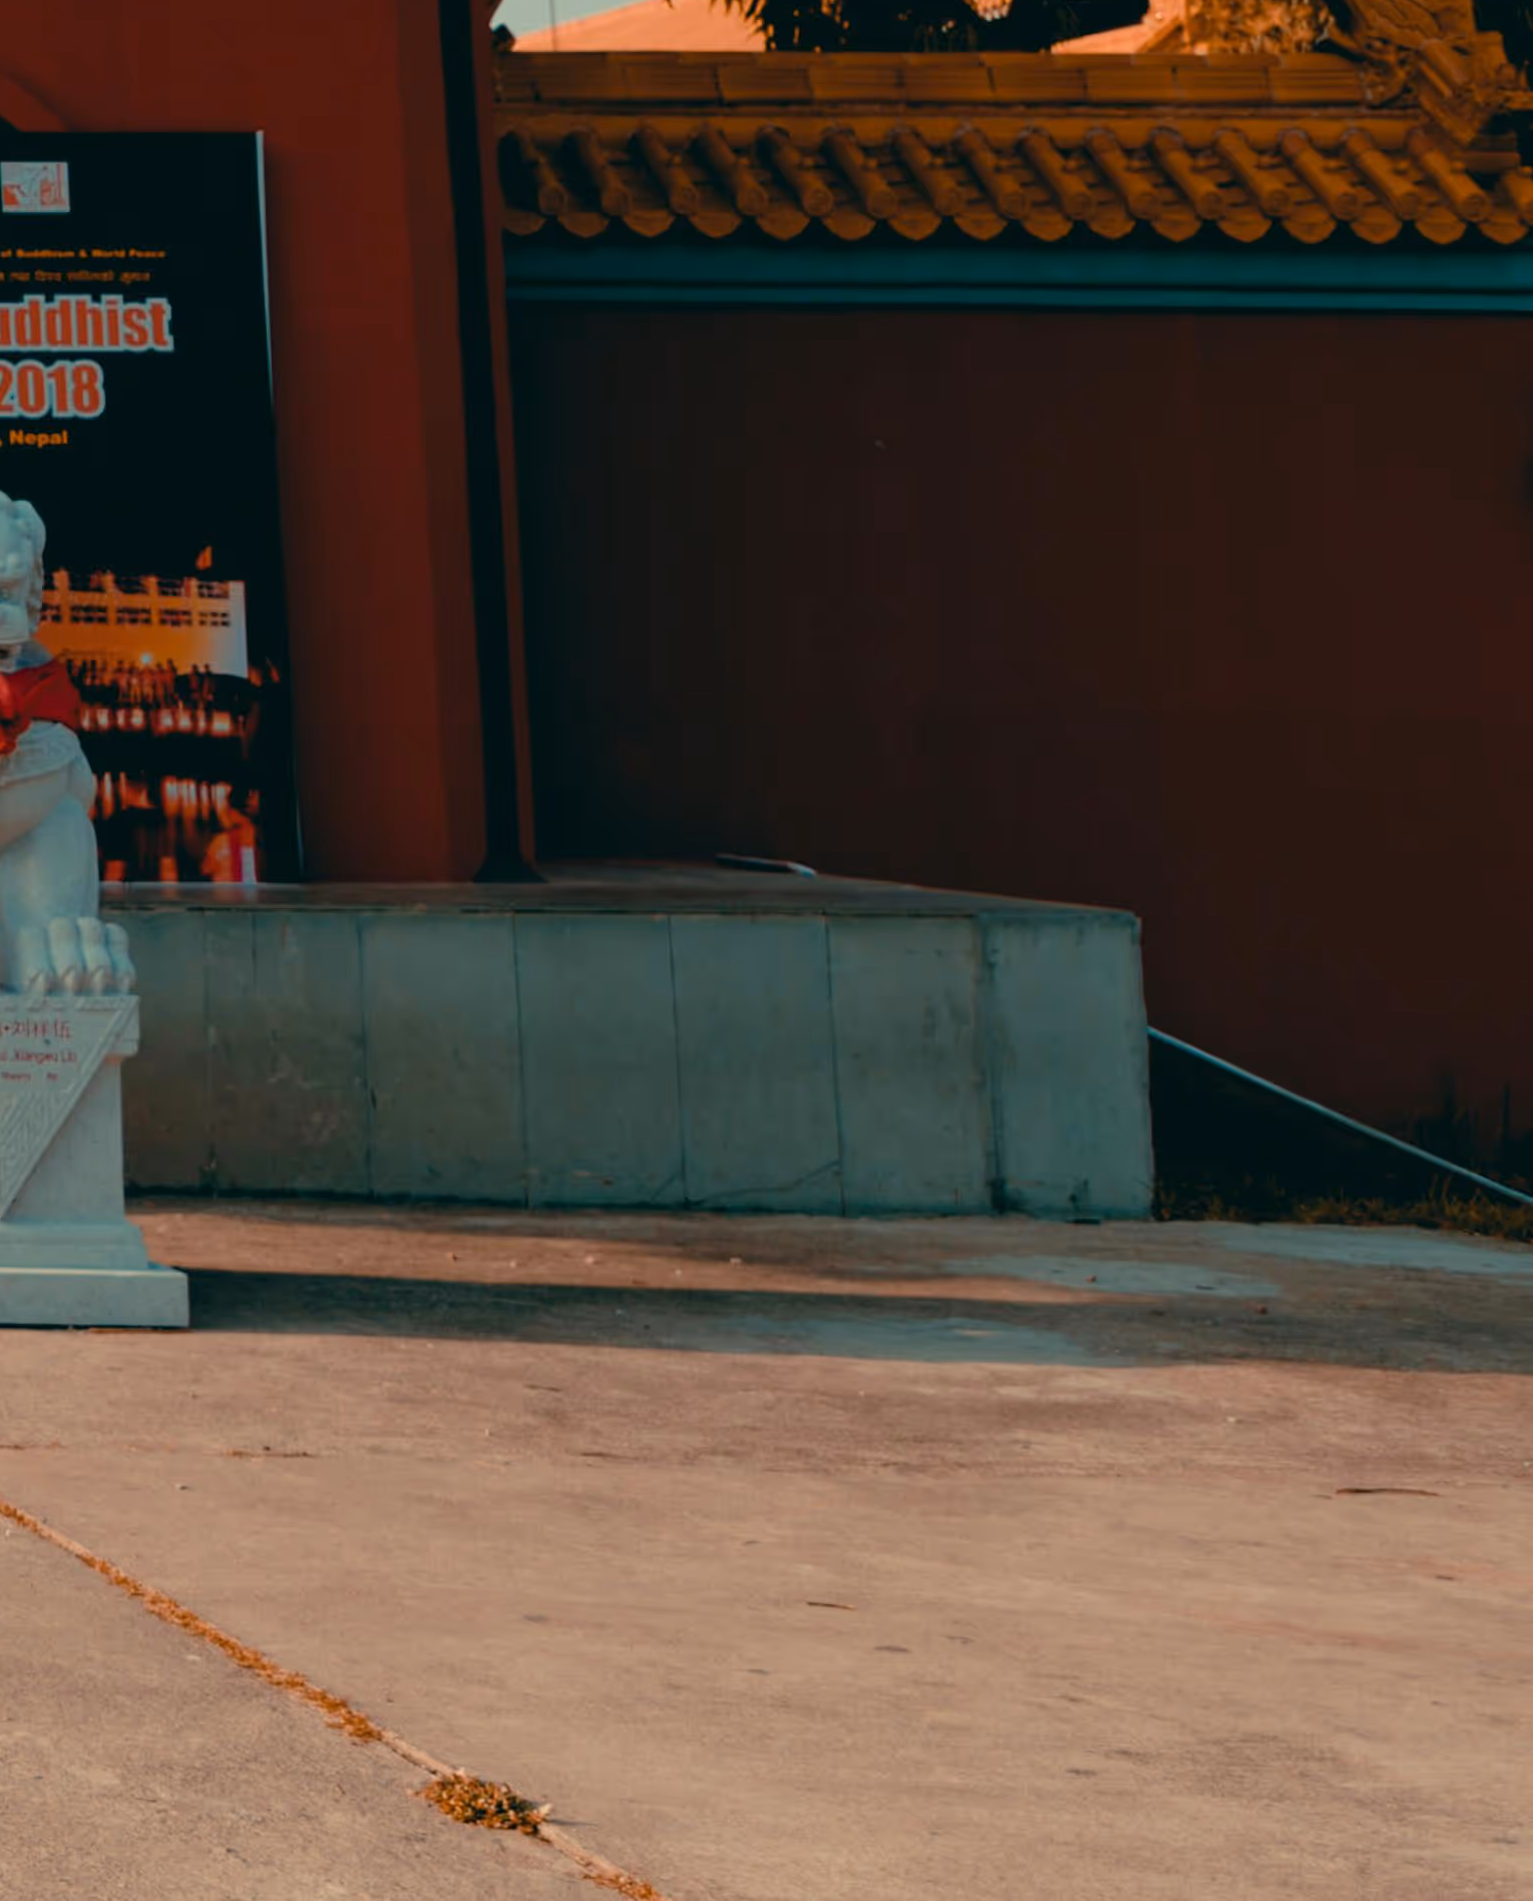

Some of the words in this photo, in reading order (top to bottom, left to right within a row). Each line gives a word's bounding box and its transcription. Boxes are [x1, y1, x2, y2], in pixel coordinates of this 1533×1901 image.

[0, 248, 14, 258] of
[16, 249, 75, 258] Buddhism
[79, 249, 89, 258] &
[129, 249, 166, 258] Peace
[9, 429, 69, 448] Nepal
